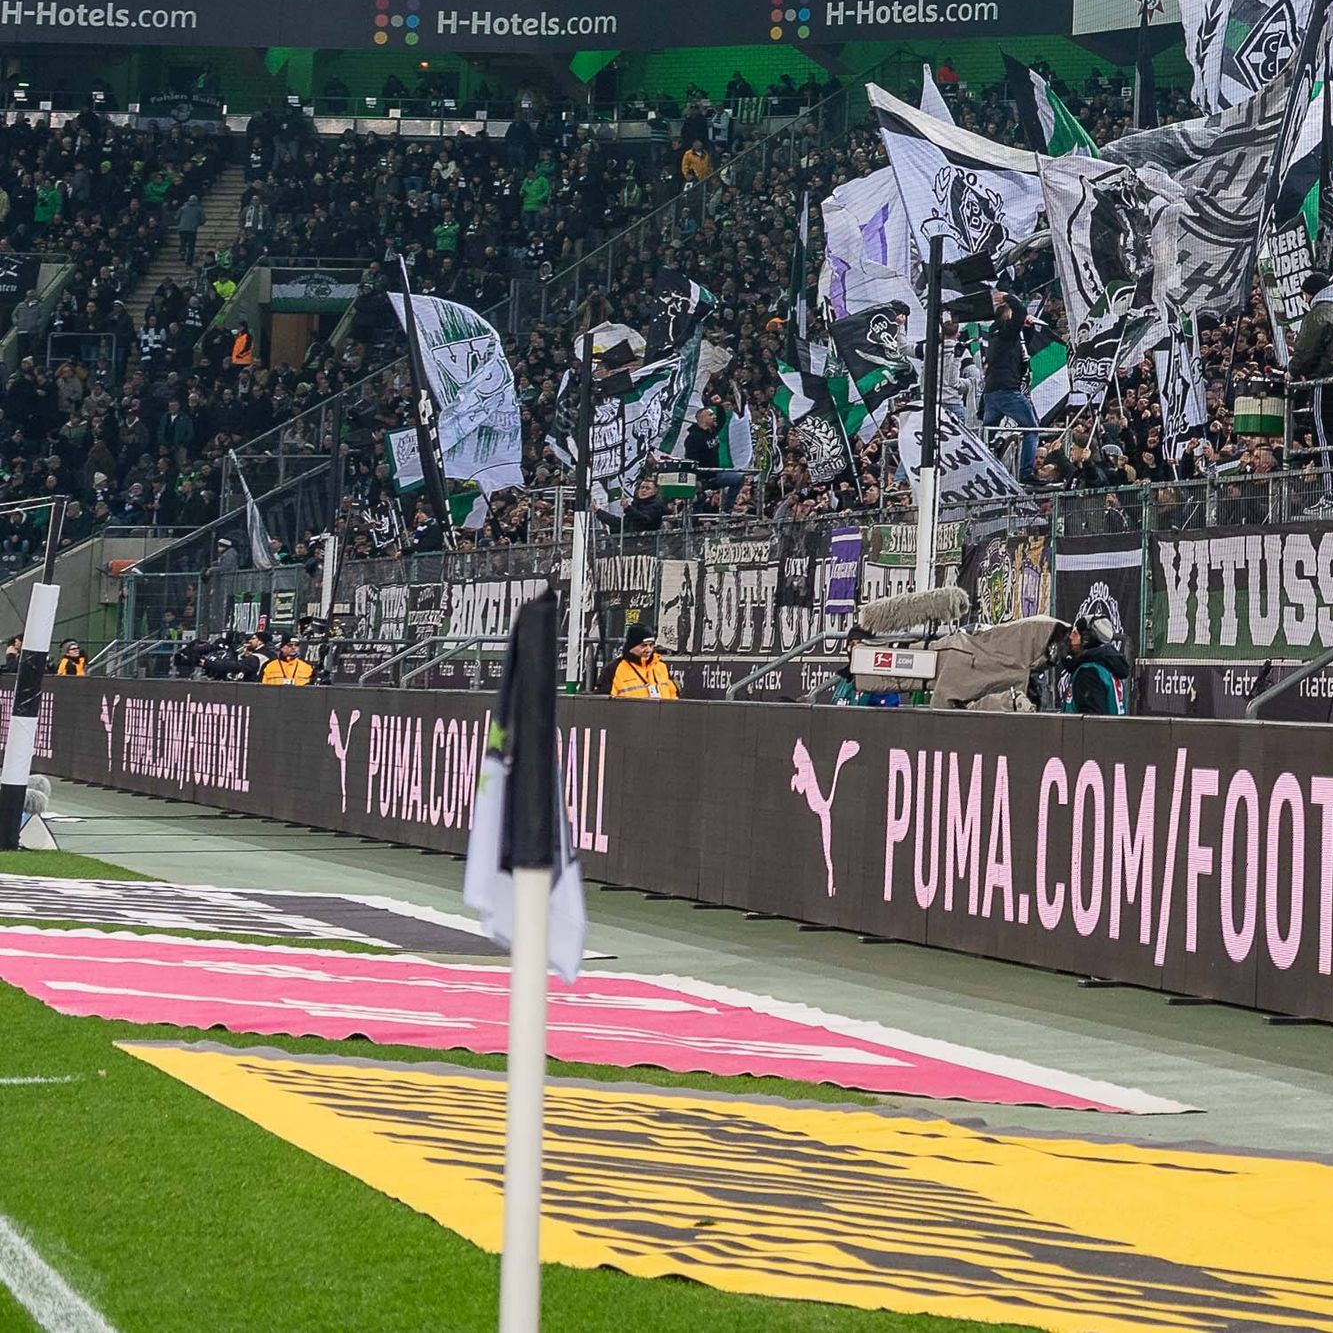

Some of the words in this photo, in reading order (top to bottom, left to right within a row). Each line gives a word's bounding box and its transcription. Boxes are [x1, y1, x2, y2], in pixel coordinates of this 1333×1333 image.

[0, 0, 198, 31] H-Hotels.com
[436, 8, 618, 37] H-Hotels.com
[702, 664, 732, 690] flatex
[1154, 669, 1196, 695] flatex
[123, 693, 250, 792] PUMA.COM/FOOTBALL
